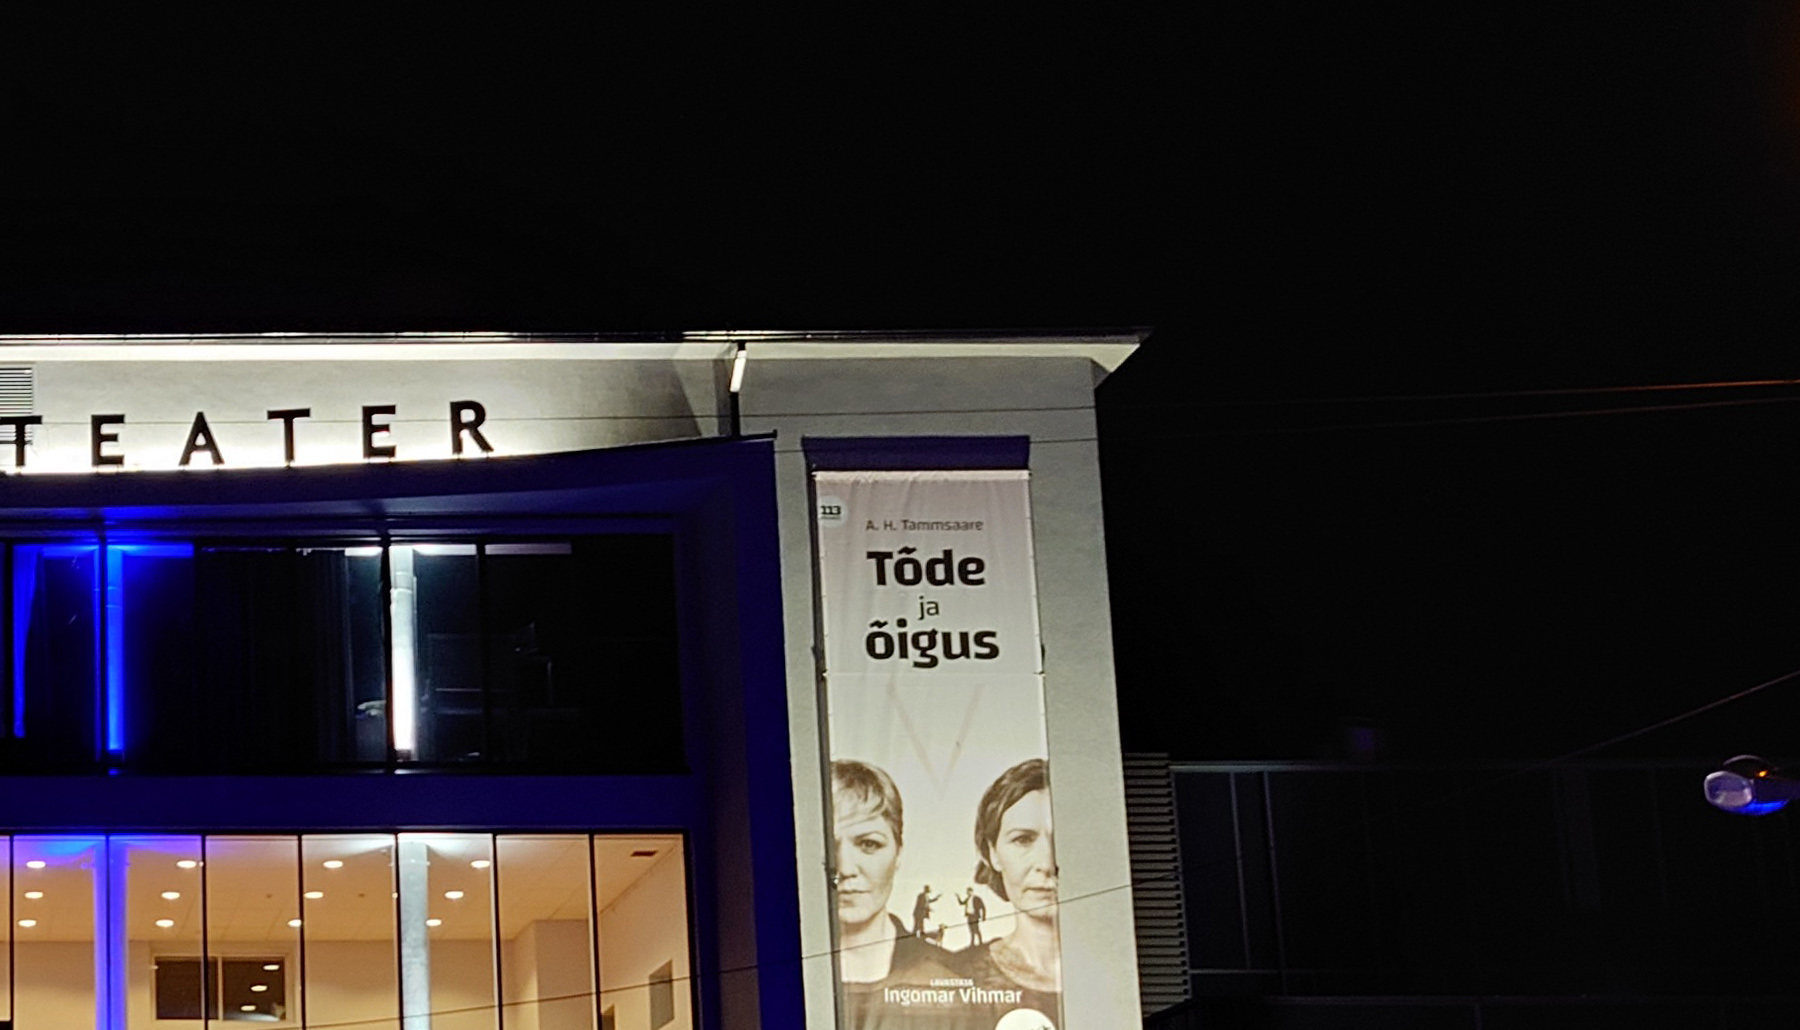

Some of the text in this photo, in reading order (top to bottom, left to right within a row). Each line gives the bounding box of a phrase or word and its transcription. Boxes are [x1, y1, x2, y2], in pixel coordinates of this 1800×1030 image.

[820, 505, 842, 515] 113
[866, 519, 984, 531] A. H. Tammsaare
[866, 546, 986, 586] Tõde
[918, 596, 940, 621] ja
[865, 618, 1000, 669] õigus
[884, 986, 1023, 1006] Ingomar Vihmar
